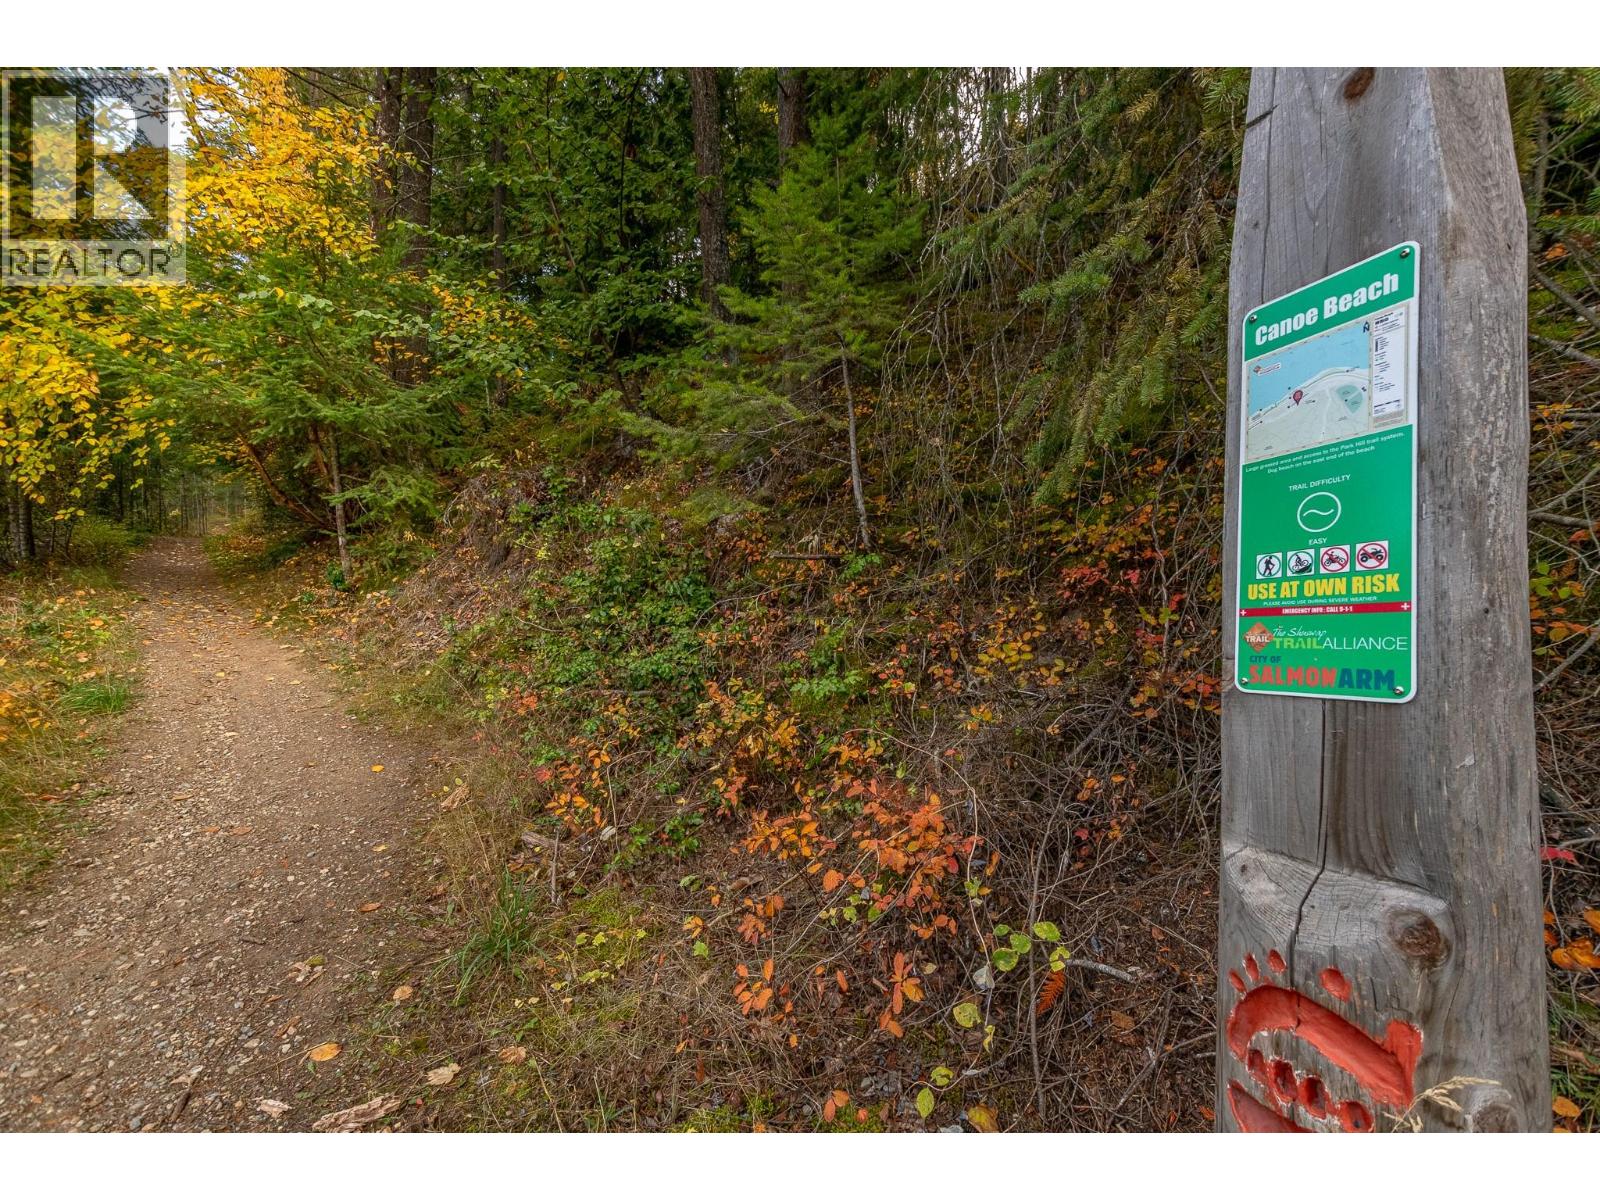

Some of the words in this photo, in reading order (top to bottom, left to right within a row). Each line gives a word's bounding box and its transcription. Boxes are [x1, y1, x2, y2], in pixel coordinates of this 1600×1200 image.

[1255, 307, 1318, 346] Canoe
[1323, 272, 1399, 319] Beach
[1340, 443, 1354, 451] Park
[1278, 463, 1295, 471] beach
[1325, 453, 1337, 461] end
[1345, 449, 1355, 457] the
[1289, 482, 1309, 492] TRAIL
[1309, 474, 1351, 488] DIFFICULTY
[1308, 537, 1328, 546] EASY
[1247, 582, 1277, 600] USE
[1280, 580, 1300, 598] AT
[1303, 577, 1347, 597] OWN
[1351, 573, 1400, 594] RISK
[1326, 605, 1338, 613] CALL
[1273, 627, 1286, 637] The
[1245, 634, 1271, 643] TRAIL
[1250, 655, 1267, 663] CITY
[1270, 655, 1282, 663] OF
